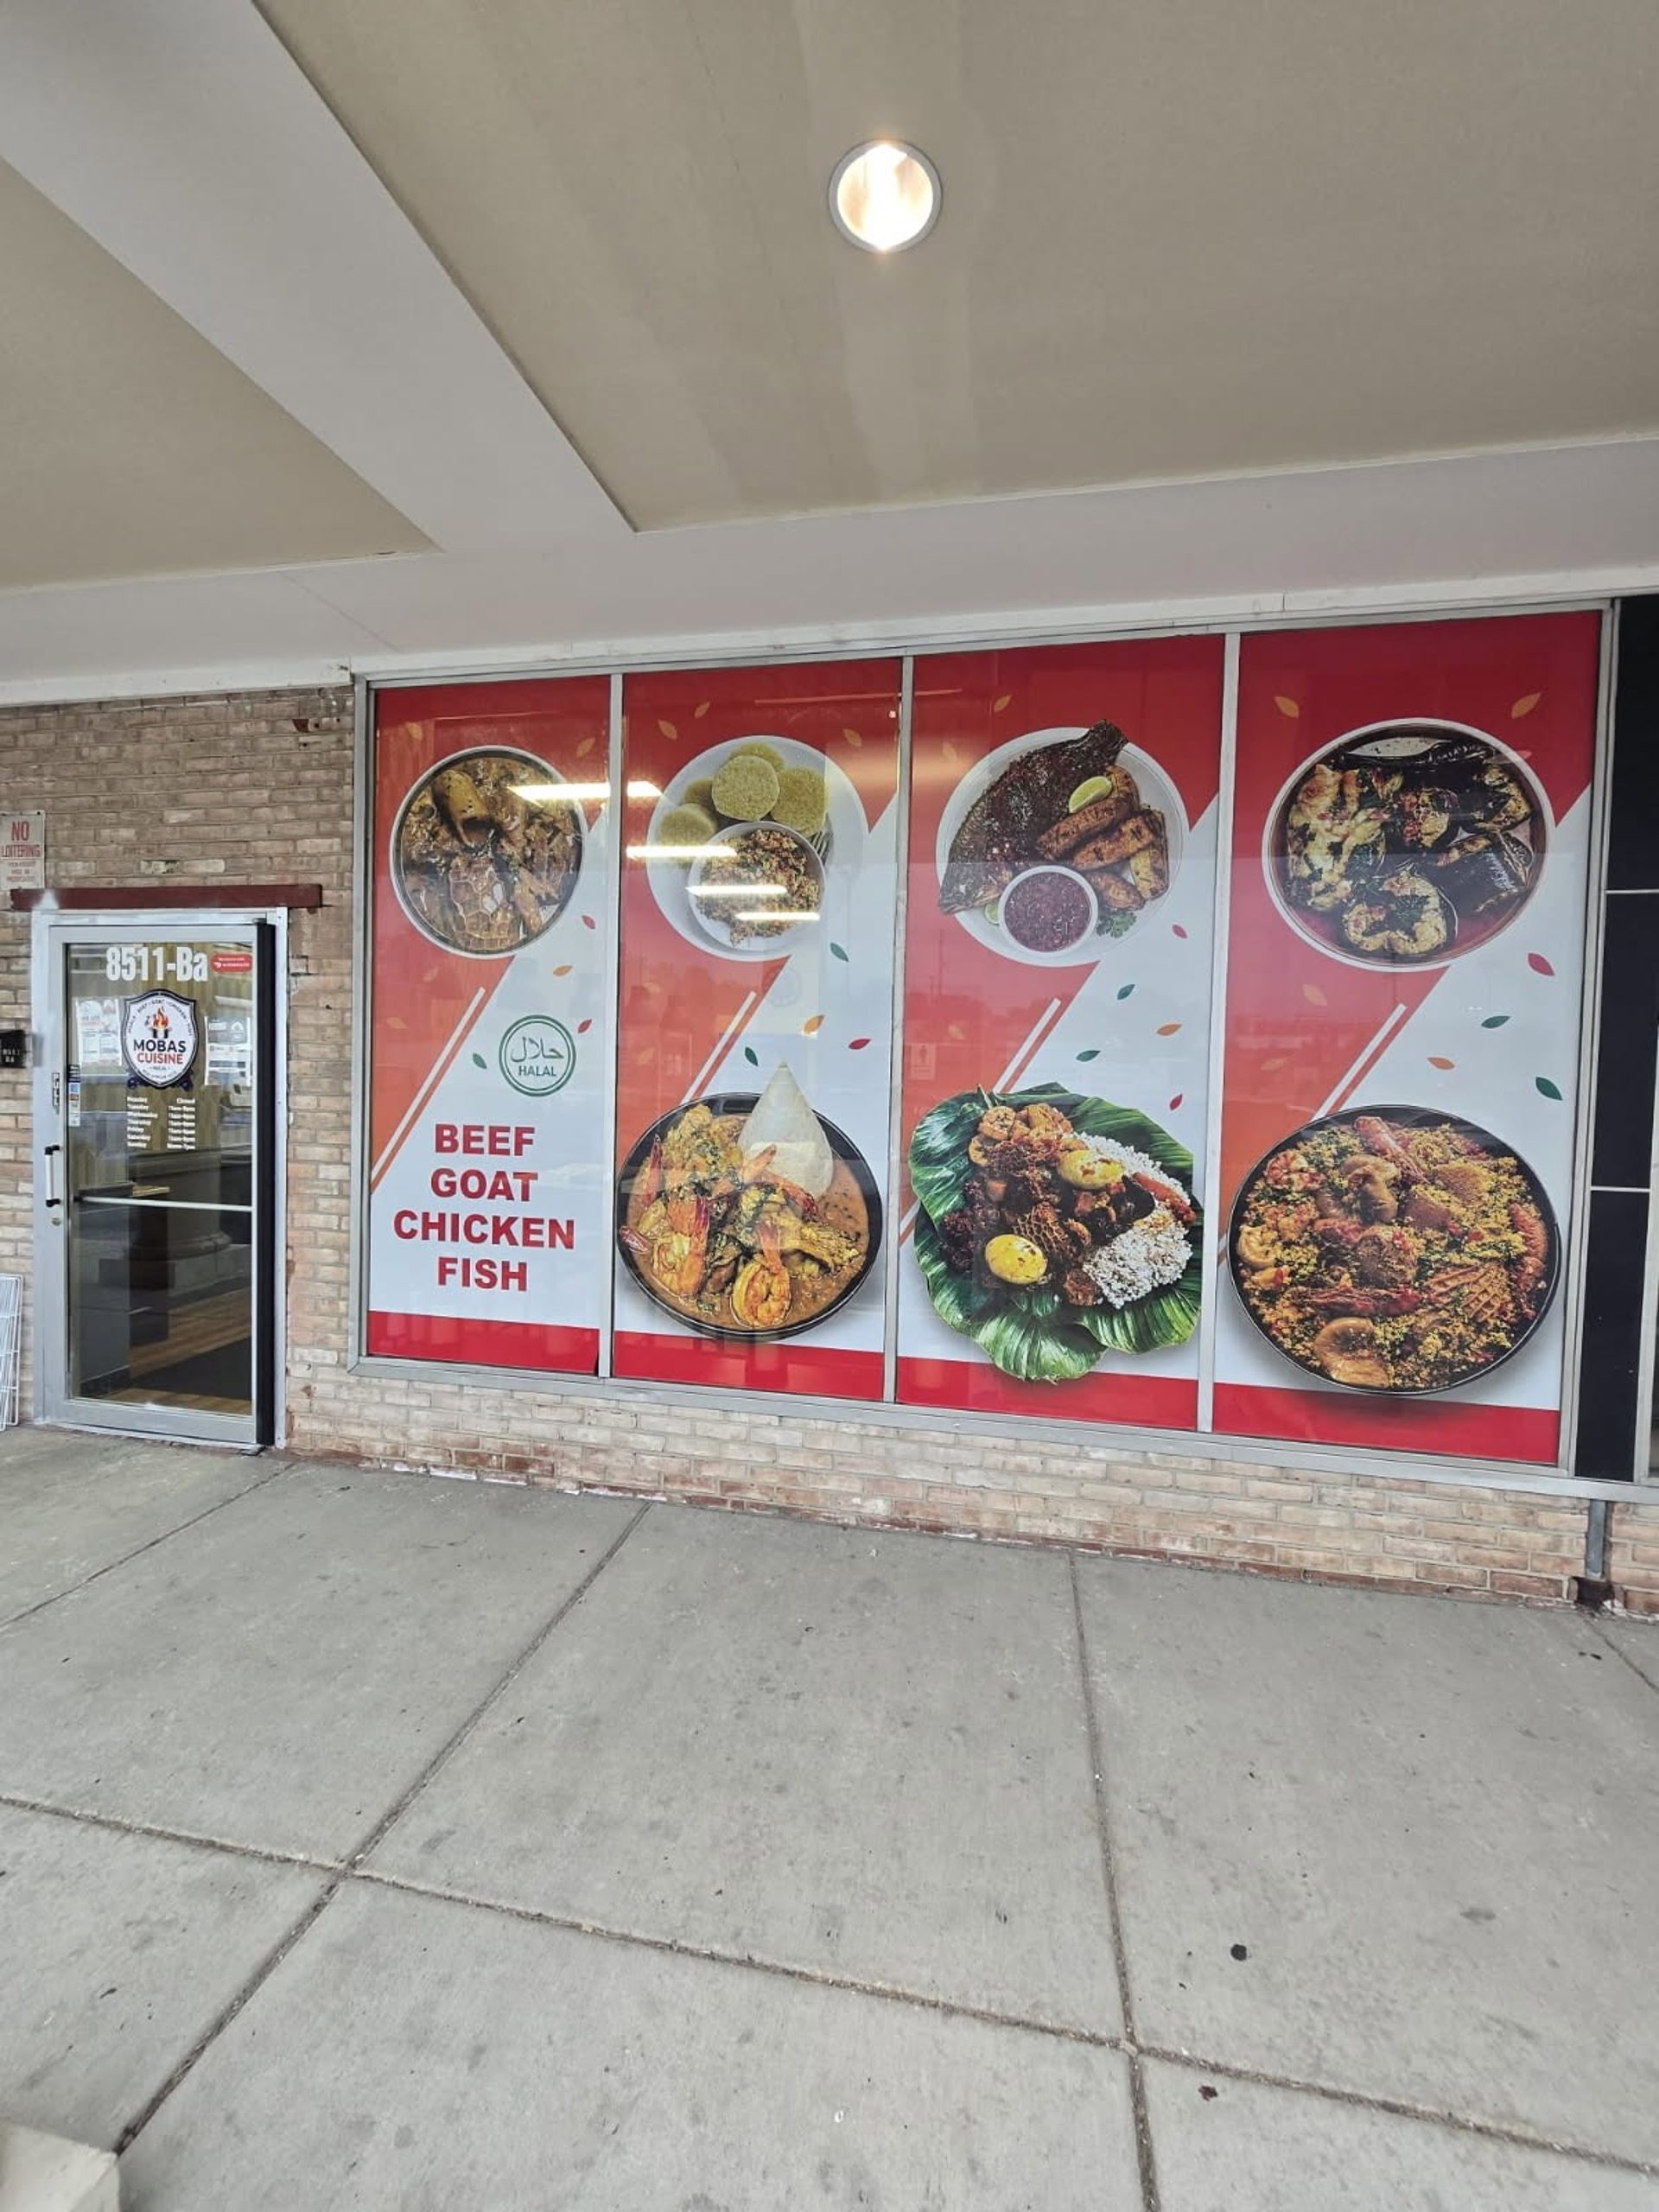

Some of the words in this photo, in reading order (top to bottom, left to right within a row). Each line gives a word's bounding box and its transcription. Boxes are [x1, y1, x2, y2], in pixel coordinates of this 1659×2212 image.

[11, 821, 29, 842] NO
[2, 844, 41, 858] LOITERING
[105, 946, 208, 982] 8511-Ba
[133, 1039, 187, 1053] MOBAS
[137, 1052, 183, 1065] CUISINE
[510, 1036, 564, 1063] حلال
[518, 1065, 556, 1077] HALAL
[435, 1123, 536, 1156] BEEF
[430, 1167, 538, 1202] GOAT
[393, 1210, 575, 1249] CHICKEN
[437, 1257, 528, 1291] FISH
